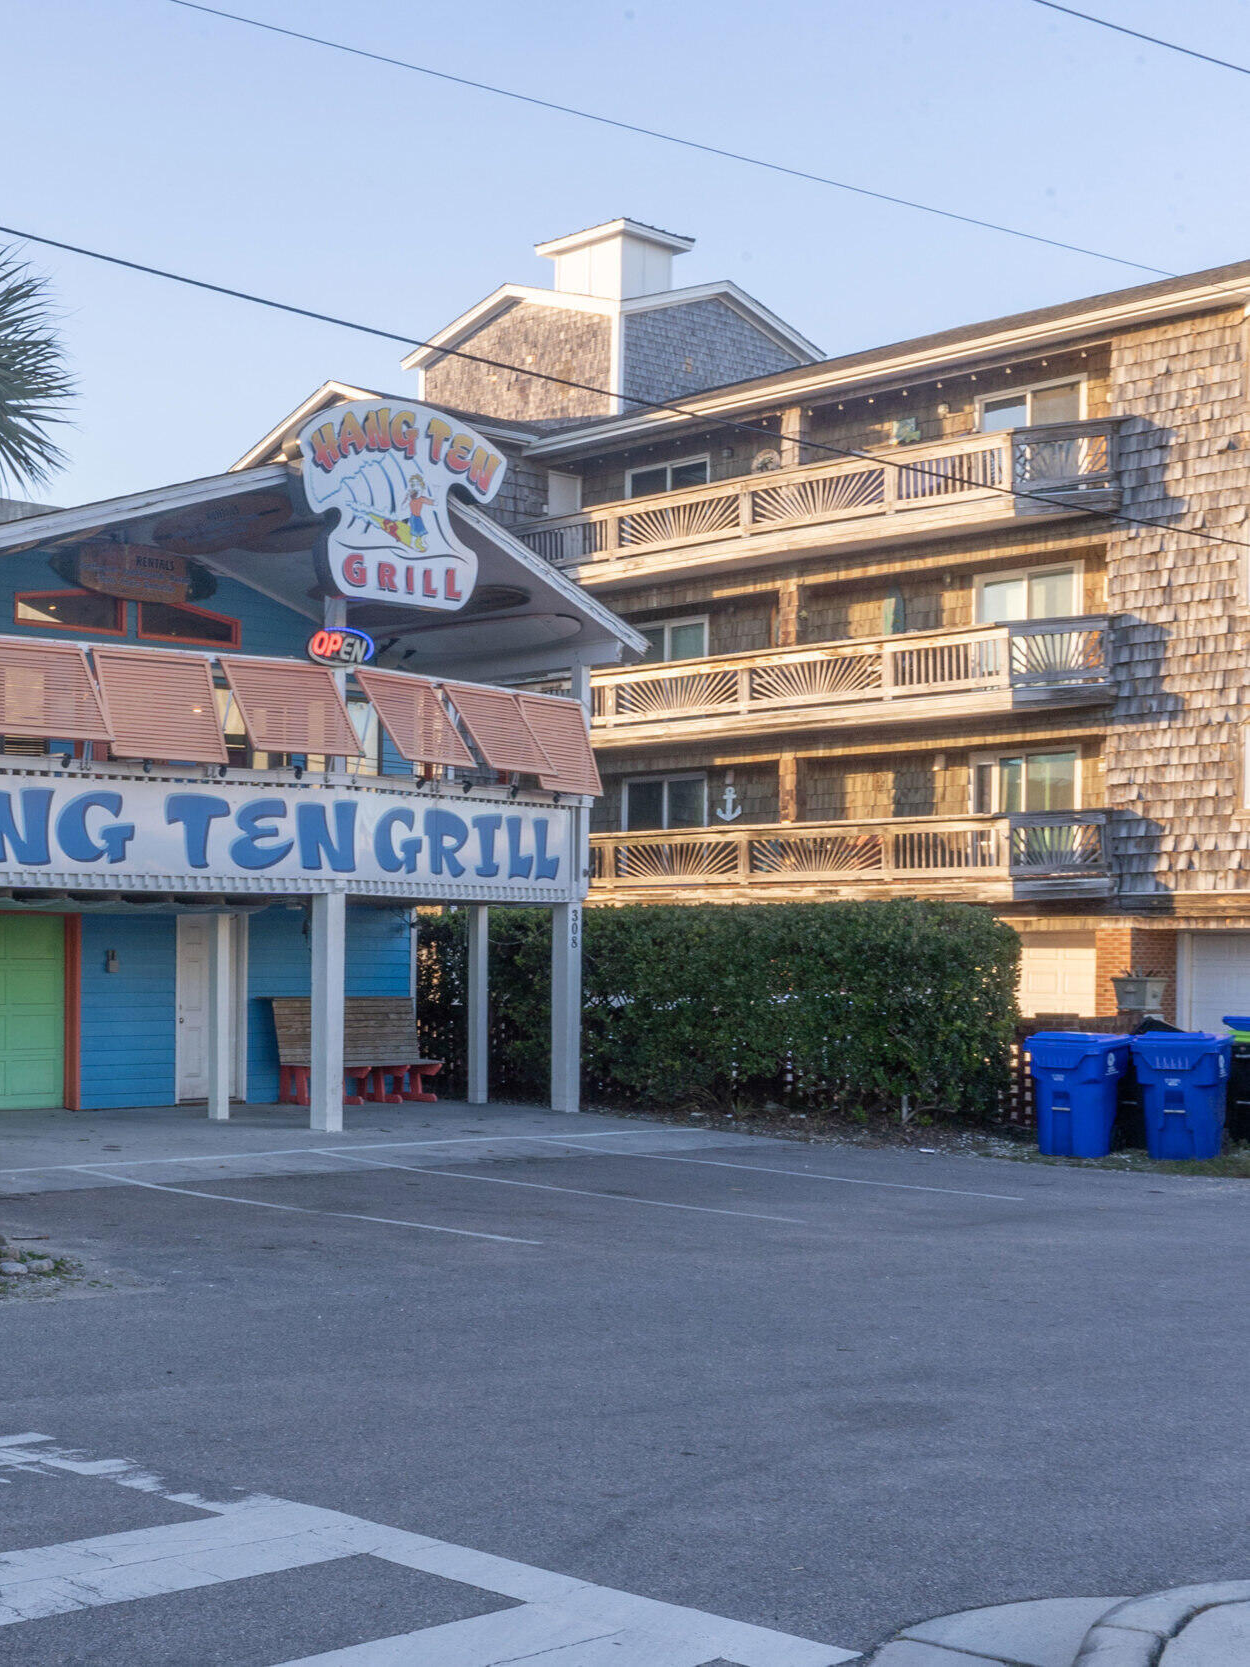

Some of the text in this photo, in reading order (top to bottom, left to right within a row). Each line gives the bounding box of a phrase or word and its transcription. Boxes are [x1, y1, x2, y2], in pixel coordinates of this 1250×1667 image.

[310, 407, 501, 496] HANG TEN
[135, 555, 175, 571] RENTALS
[343, 553, 462, 601] GRILL
[312, 630, 367, 664] OPEN
[164, 791, 358, 873] TEN
[373, 806, 561, 881] GRILL
[571, 909, 579, 949] 308
